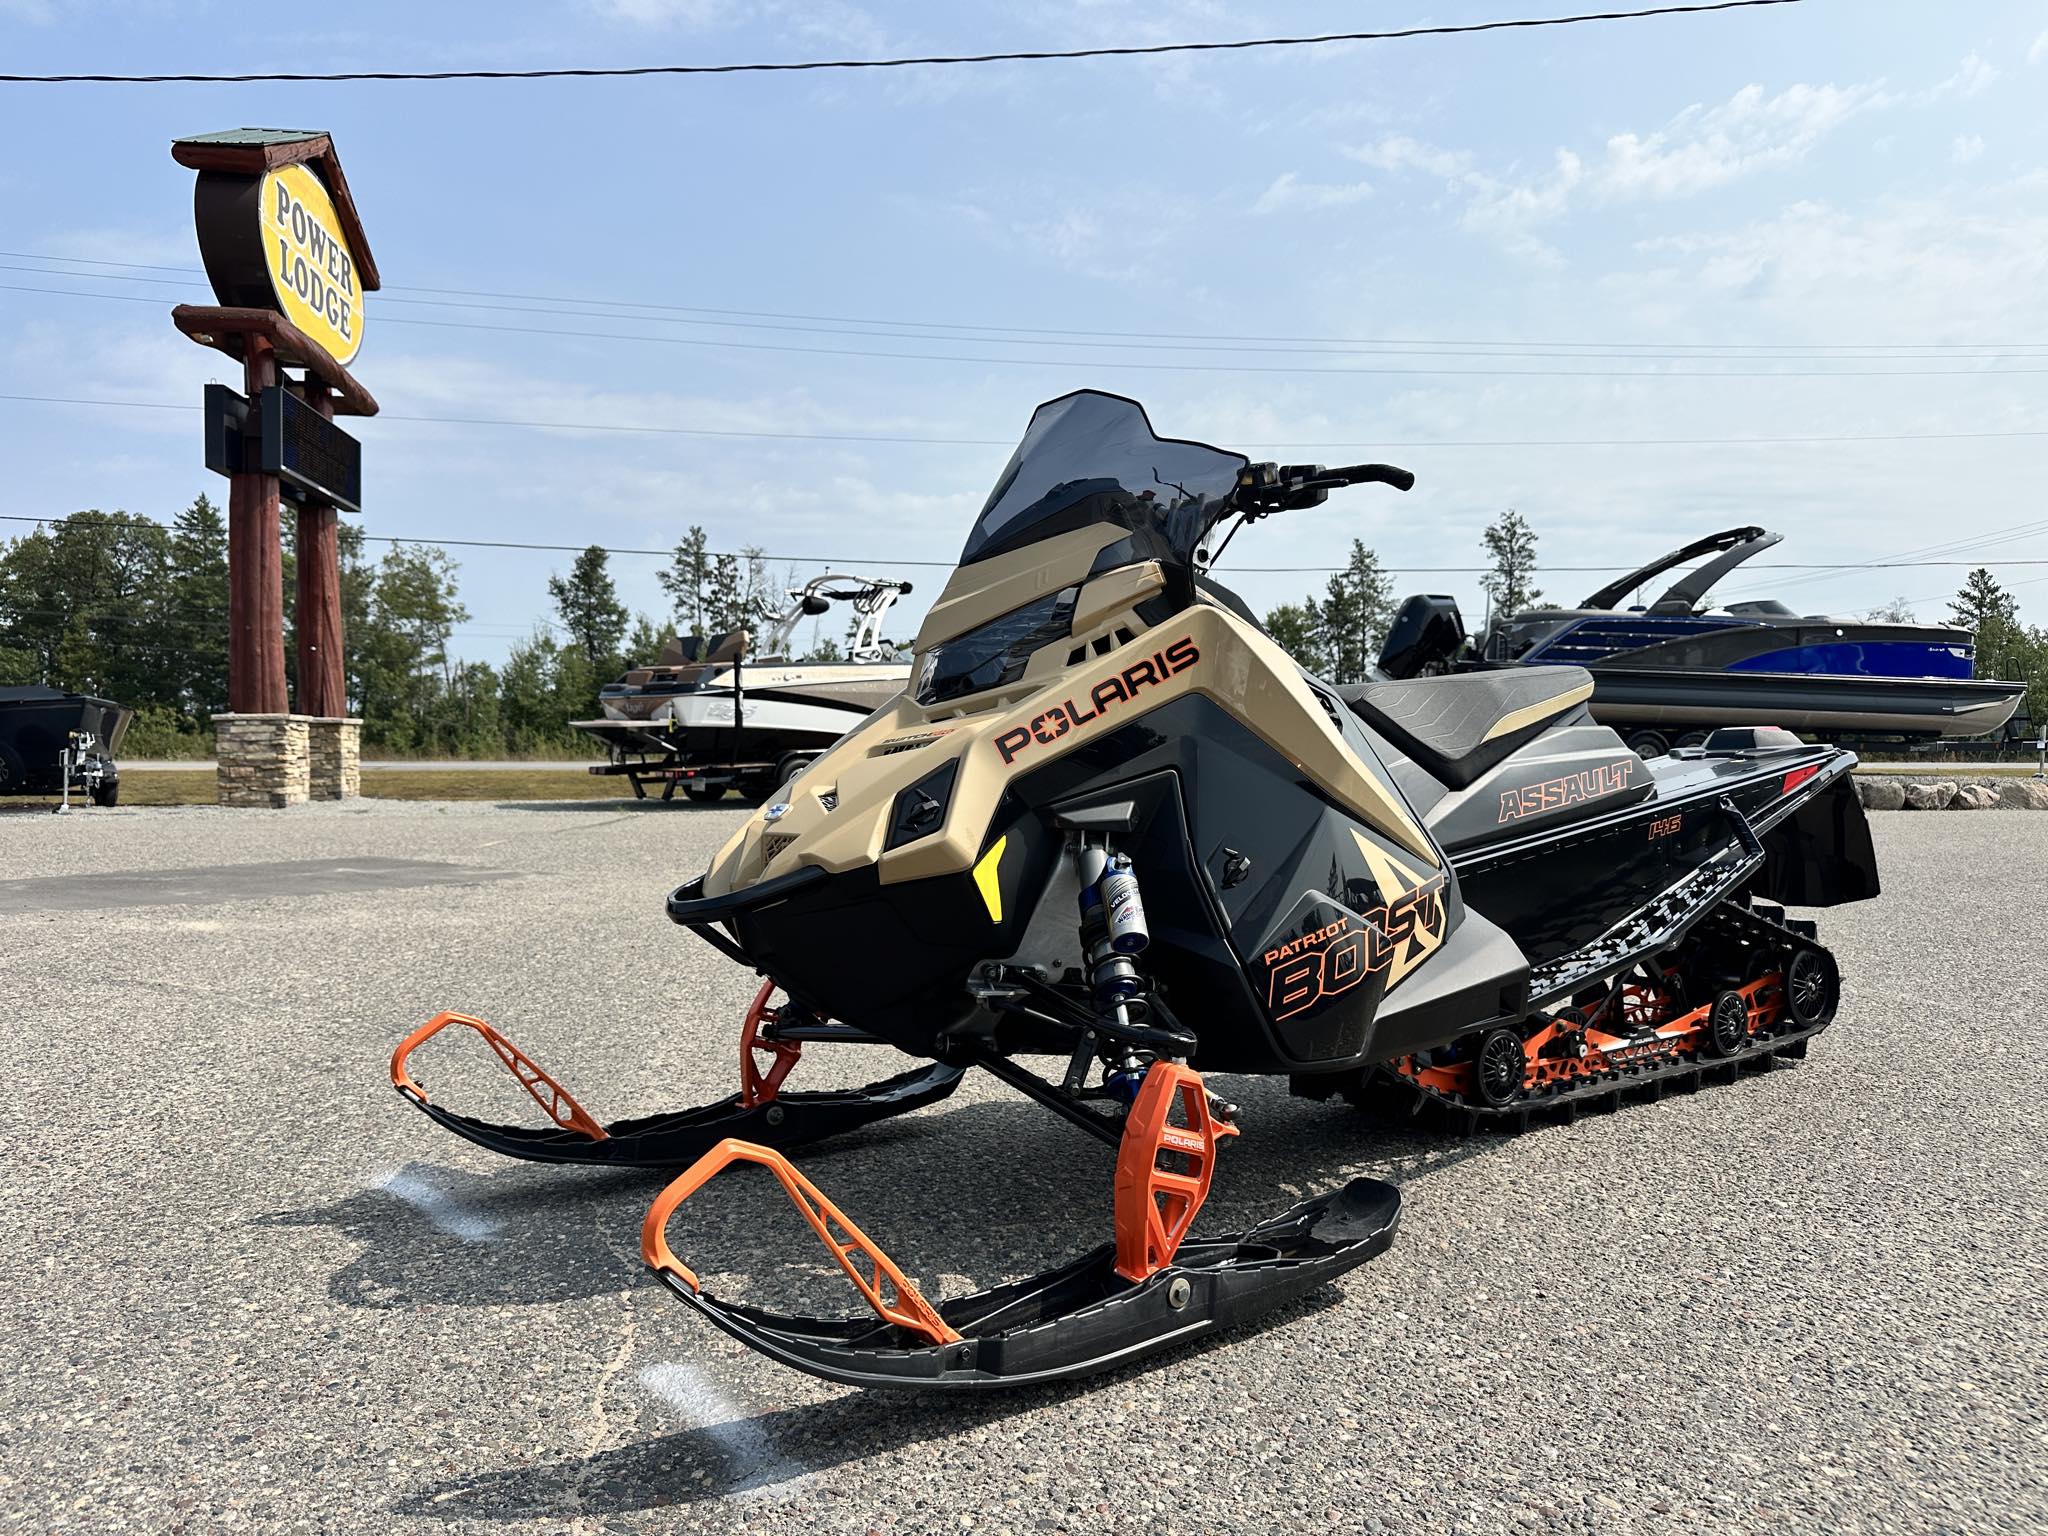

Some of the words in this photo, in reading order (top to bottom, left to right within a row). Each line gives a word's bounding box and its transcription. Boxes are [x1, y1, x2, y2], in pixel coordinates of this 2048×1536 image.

[277, 181, 353, 297] POWER
[280, 239, 351, 341] LODGE
[994, 636, 1201, 764] POLARIS
[1498, 760, 1632, 823] ASSAULT
[1648, 814, 1682, 840] 146
[1264, 917, 1348, 966] PATRIOT
[1268, 873, 1444, 1021] BOOST
[1163, 1134, 1205, 1151] POLARIS
[902, 1278, 942, 1327] POLARIS
